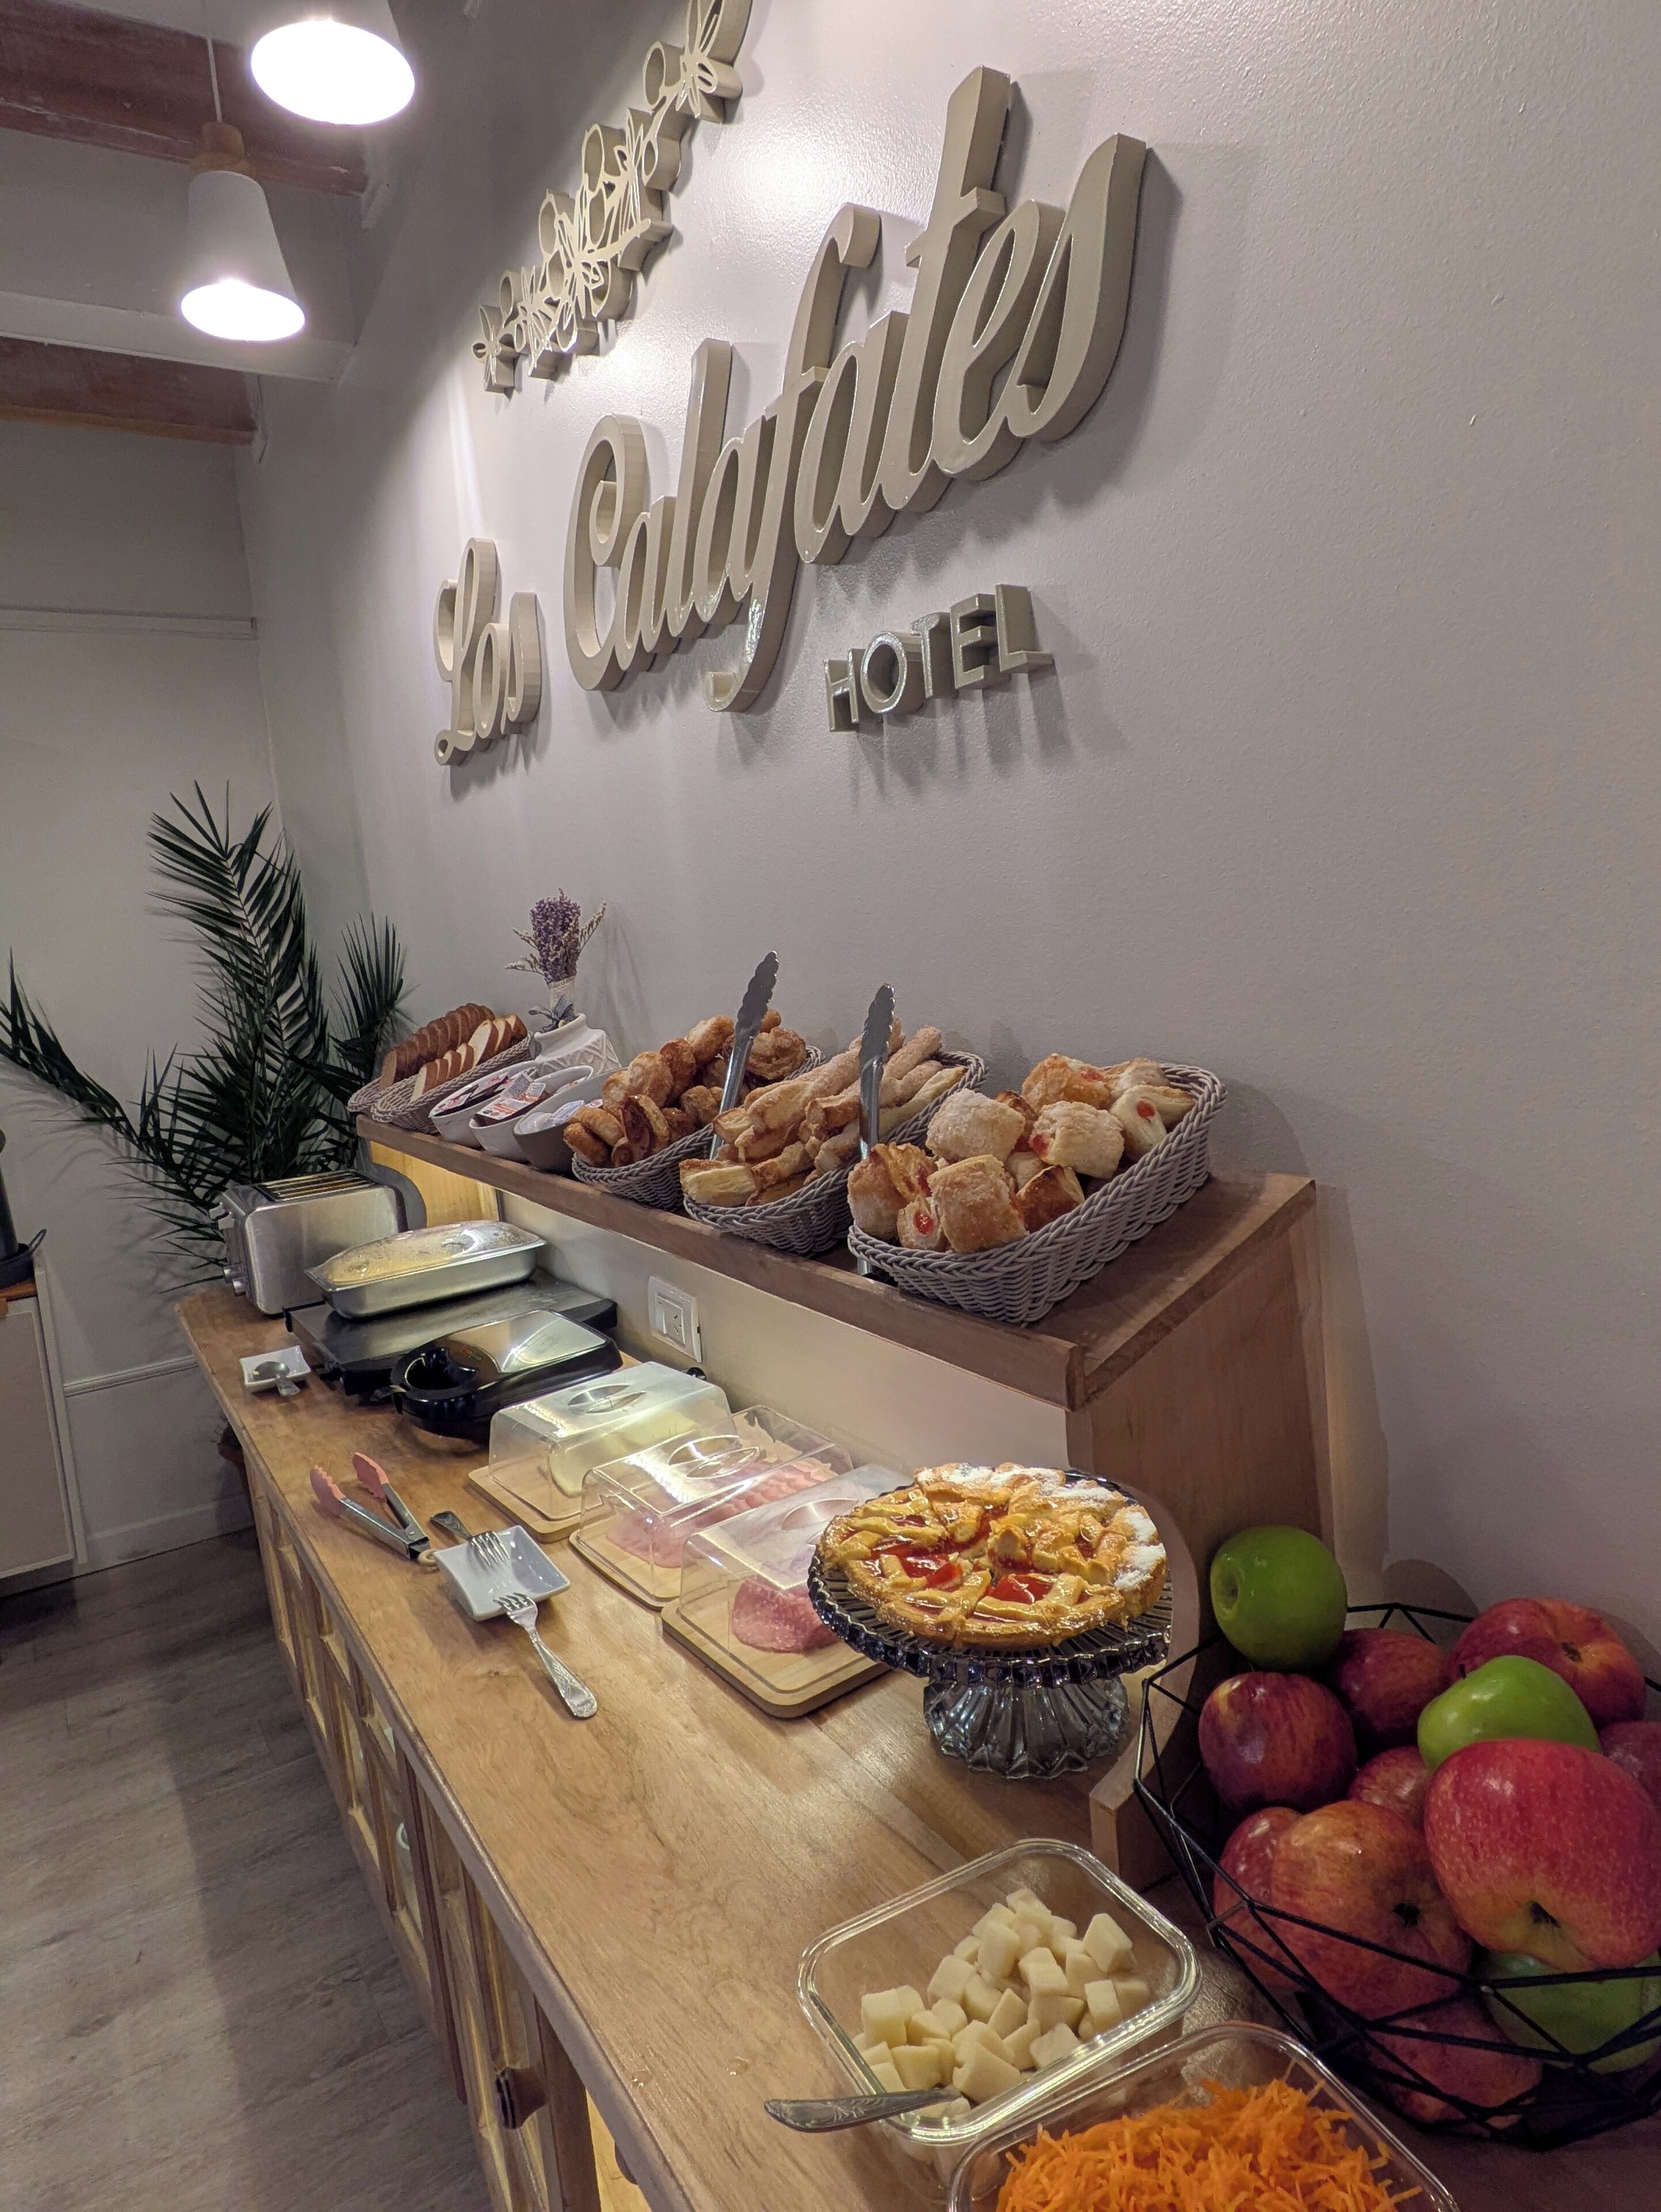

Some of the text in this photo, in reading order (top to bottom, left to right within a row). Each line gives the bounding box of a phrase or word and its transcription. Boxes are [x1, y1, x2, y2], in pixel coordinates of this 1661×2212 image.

[433, 65, 1145, 765] Los Calafates
[823, 584, 1052, 732] HOTEL
